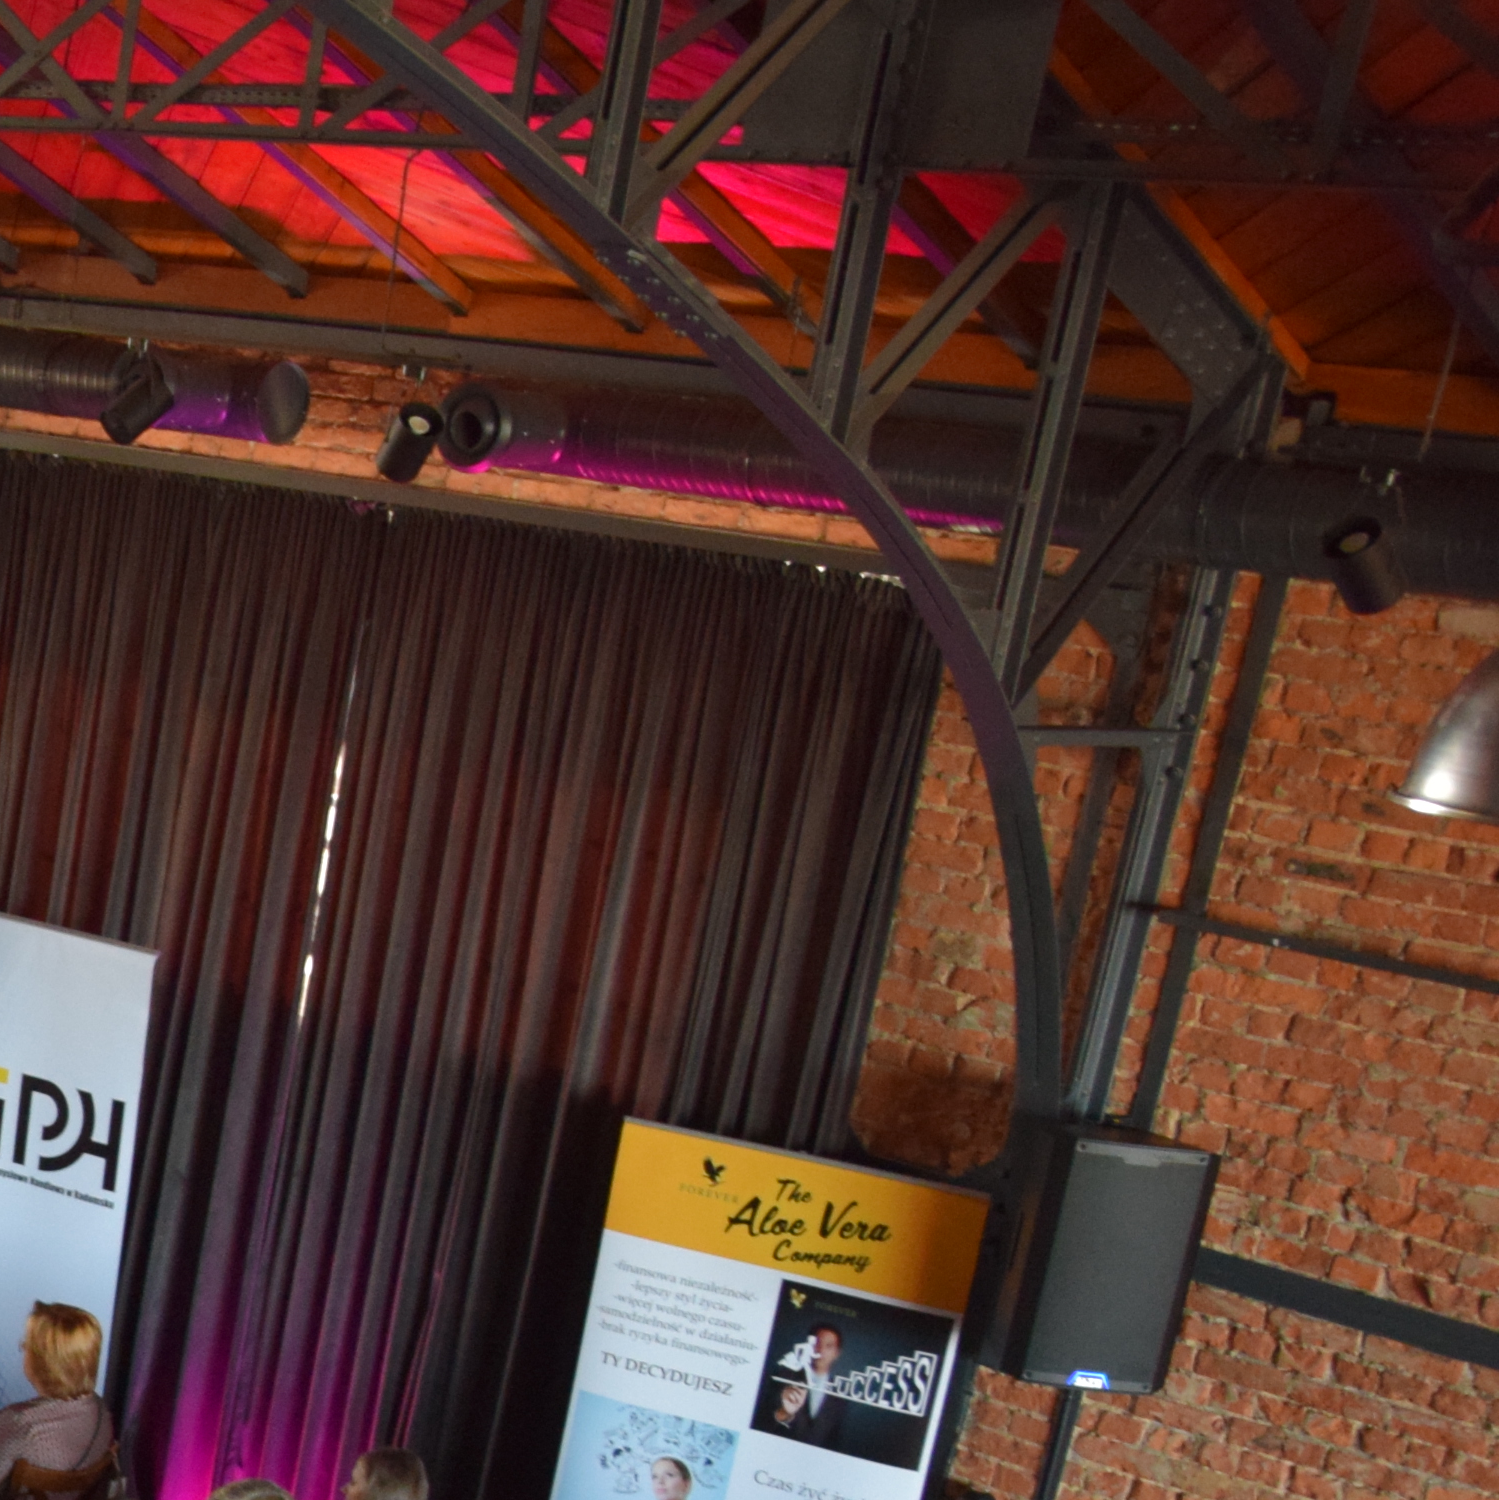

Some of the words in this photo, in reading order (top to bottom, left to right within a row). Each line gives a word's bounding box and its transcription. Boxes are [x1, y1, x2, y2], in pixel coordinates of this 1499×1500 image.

[776, 1178, 814, 1204] The
[724, 1196, 807, 1237] Aloe
[818, 1201, 892, 1243] Vera
[772, 1238, 871, 1274] Company
[602, 1351, 623, 1368] TY
[625, 1358, 734, 1397] DECYDUJESZ
[754, 1469, 793, 1493] Czas
